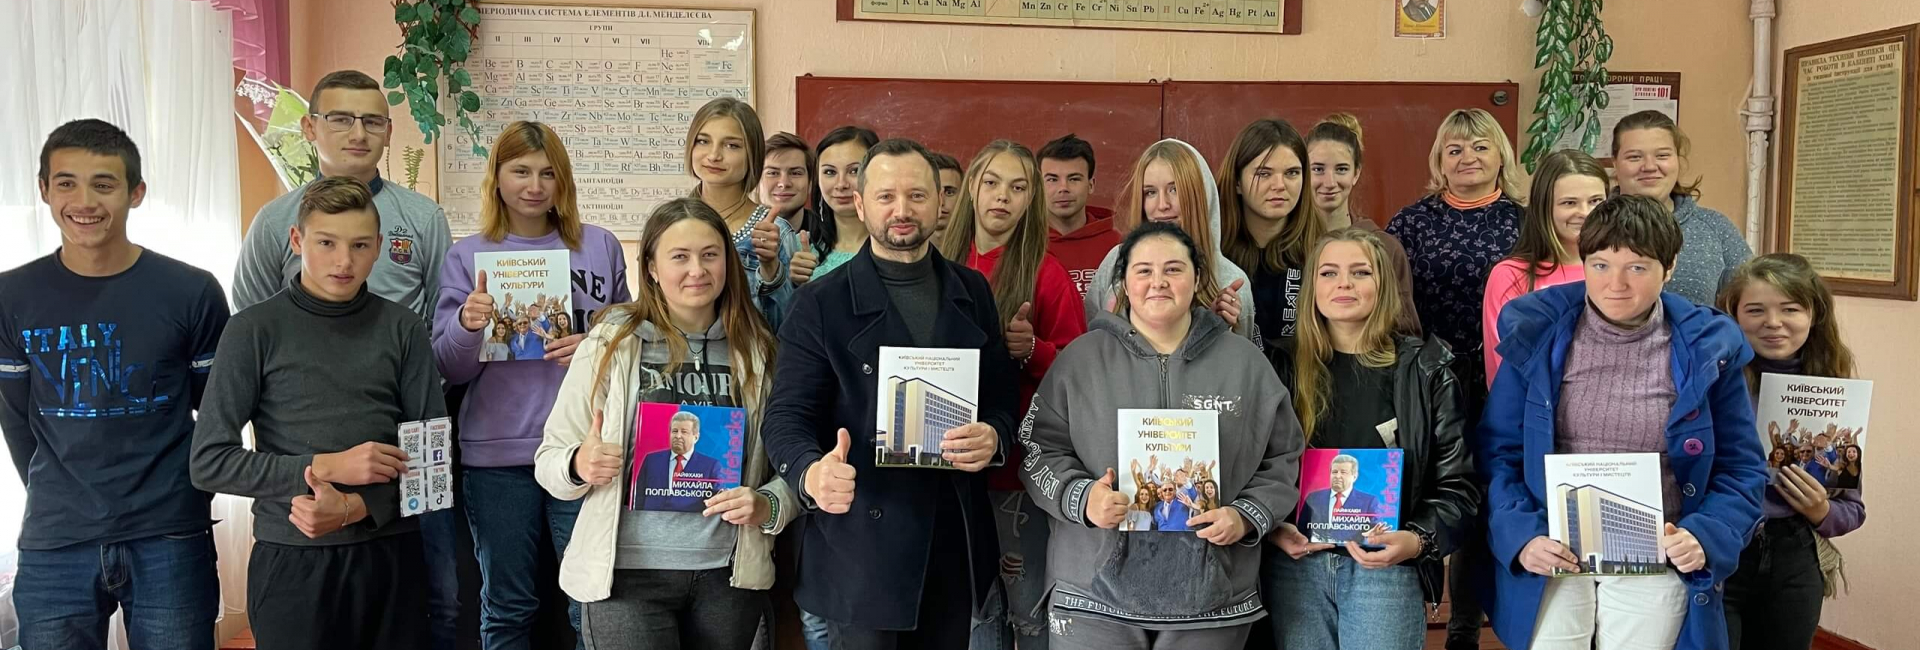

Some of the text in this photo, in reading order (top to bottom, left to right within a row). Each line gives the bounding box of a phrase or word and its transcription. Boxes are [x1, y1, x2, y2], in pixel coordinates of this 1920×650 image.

[538, 9, 581, 19] СИСТЕМА
[584, 10, 636, 20] ЕЛЕМЕНТІВ
[953, 0, 966, 9] Mg
[1022, 0, 1036, 10] Mn
[1040, 0, 1052, 10] Zn
[1058, 2, 1069, 10] Cr
[1075, 3, 1086, 11] Fe
[1110, 3, 1120, 12] Ni
[1127, 4, 1138, 13] Sn
[1143, 5, 1155, 14] Pb
[1178, 6, 1189, 15] Cu
[1212, 7, 1225, 18] Ag
[1229, 7, 1242, 18] Hg
[1248, 8, 1257, 17] Pt
[1263, 9, 1276, 18] Au
[661, 49, 673, 58] He
[485, 60, 732, 71] Be B C N O F Ne Fe
[484, 72, 675, 84] Mg Al Si P S Cl Ar
[1640, 76, 1663, 84] ПРАЦІ
[485, 84, 497, 94] Ca
[531, 86, 541, 95] Sc
[562, 86, 571, 95] Ti
[591, 86, 599, 95] V
[619, 87, 630, 95] Cr
[646, 87, 660, 96] Mn
[678, 88, 689, 97] Fe
[705, 88, 718, 97] Co
[1657, 87, 1669, 98] 101
[501, 97, 674, 109] Zn Ga Ge As Se Br Kr
[487, 110, 496, 119] Sr
[533, 110, 540, 119] Y
[560, 111, 571, 120] Zr
[590, 111, 603, 121] Nb
[617, 112, 631, 121] Mo
[650, 112, 660, 121] Tc
[677, 113, 689, 122] Ru
[574, 124, 586, 133] Sb
[604, 125, 615, 134] Te
[662, 126, 675, 135] Xe
[456, 135, 469, 145] Cs
[592, 137, 602, 146] Ta
[620, 137, 630, 146] W
[649, 138, 660, 147] Re
[575, 150, 674, 160] Bi Po At Rn
[447, 162, 661, 172] 7 Fr Rf Bh
[496, 257, 547, 267] КИЇВСЬКИЙ
[492, 270, 550, 280] УНІВЕРСИТЕТ
[500, 281, 545, 291] КУЛЬТУРИ
[22, 323, 118, 354] ITALY
[1787, 384, 1845, 395] КИЇВСЬКИЙ
[1193, 399, 1233, 411] SGNT
[1780, 395, 1847, 407] УНІВЕРСИТЕТ
[1787, 408, 1838, 418] КУЛЬТУРИ
[672, 480, 714, 490] МИХАЙЛА
[645, 487, 713, 498] ПОПЛАВСЬКОГО
[1331, 515, 1371, 523] МИХАЙЛА
[1306, 522, 1371, 531] ПОПЛАВСЬКОГО
[1064, 596, 1085, 608] THE
[1220, 599, 1254, 616] FUTURE
